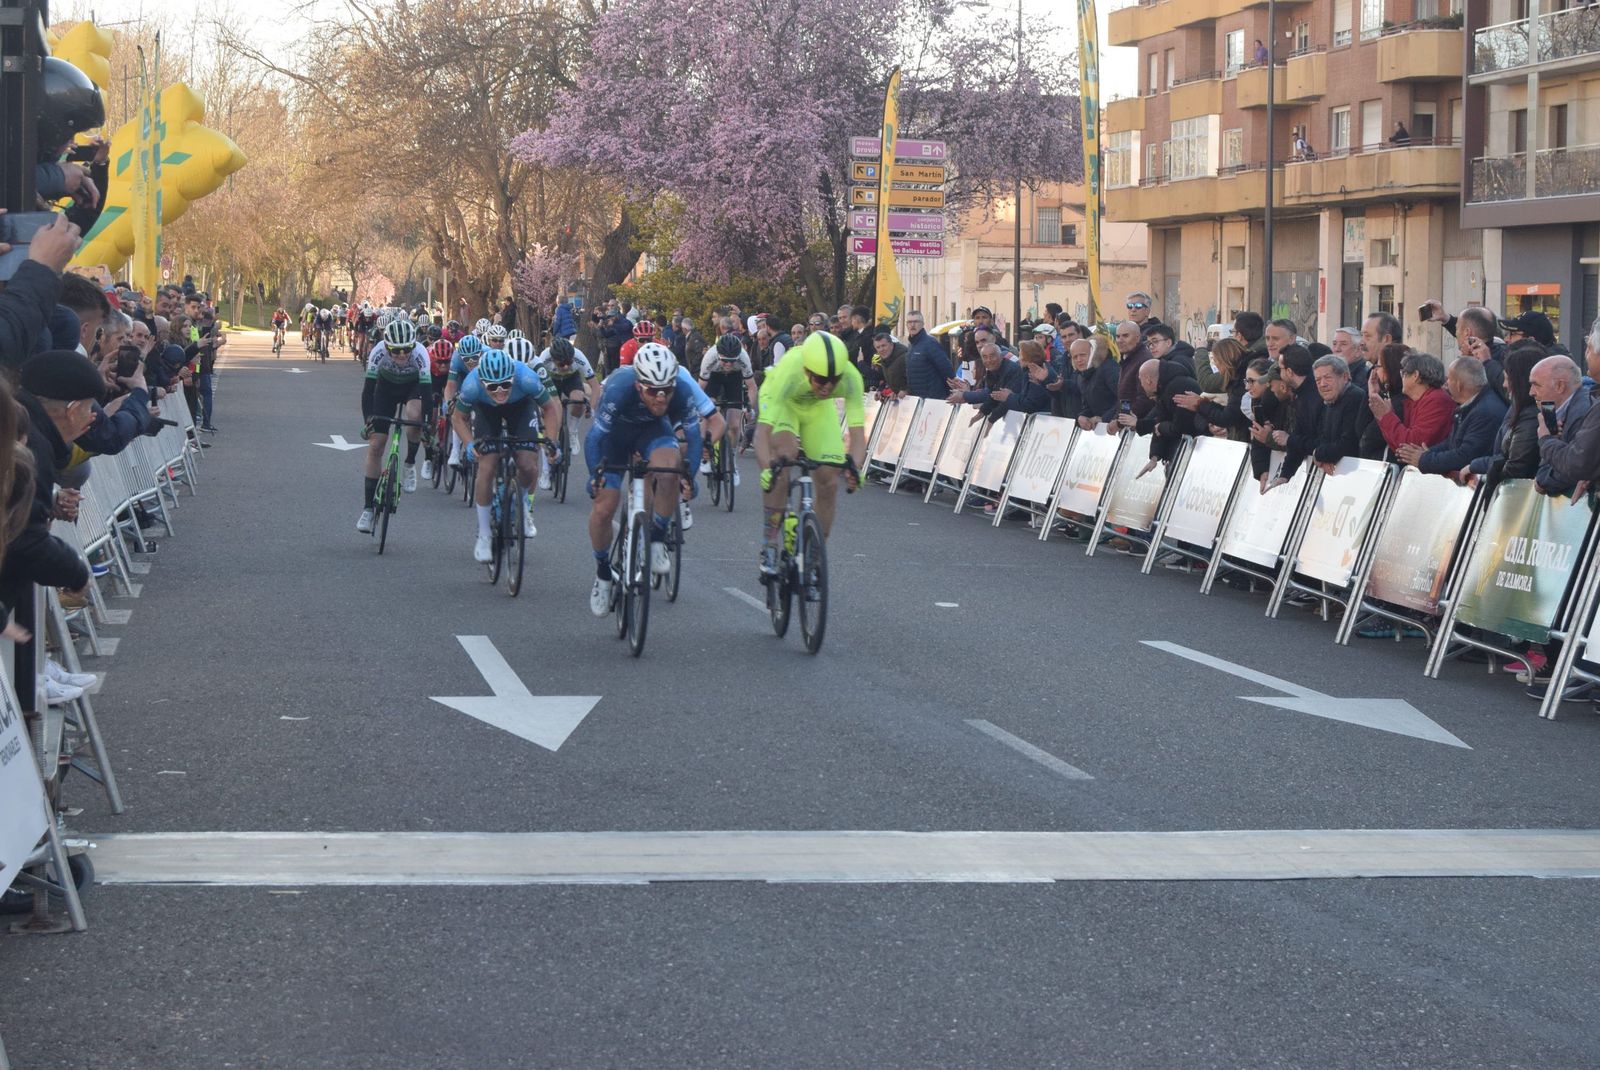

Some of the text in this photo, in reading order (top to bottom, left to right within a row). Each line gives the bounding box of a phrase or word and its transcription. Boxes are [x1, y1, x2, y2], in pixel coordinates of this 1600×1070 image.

[1504, 535, 1573, 572] CAJA RURAL
[1495, 570, 1533, 592] DE ZAMORA
